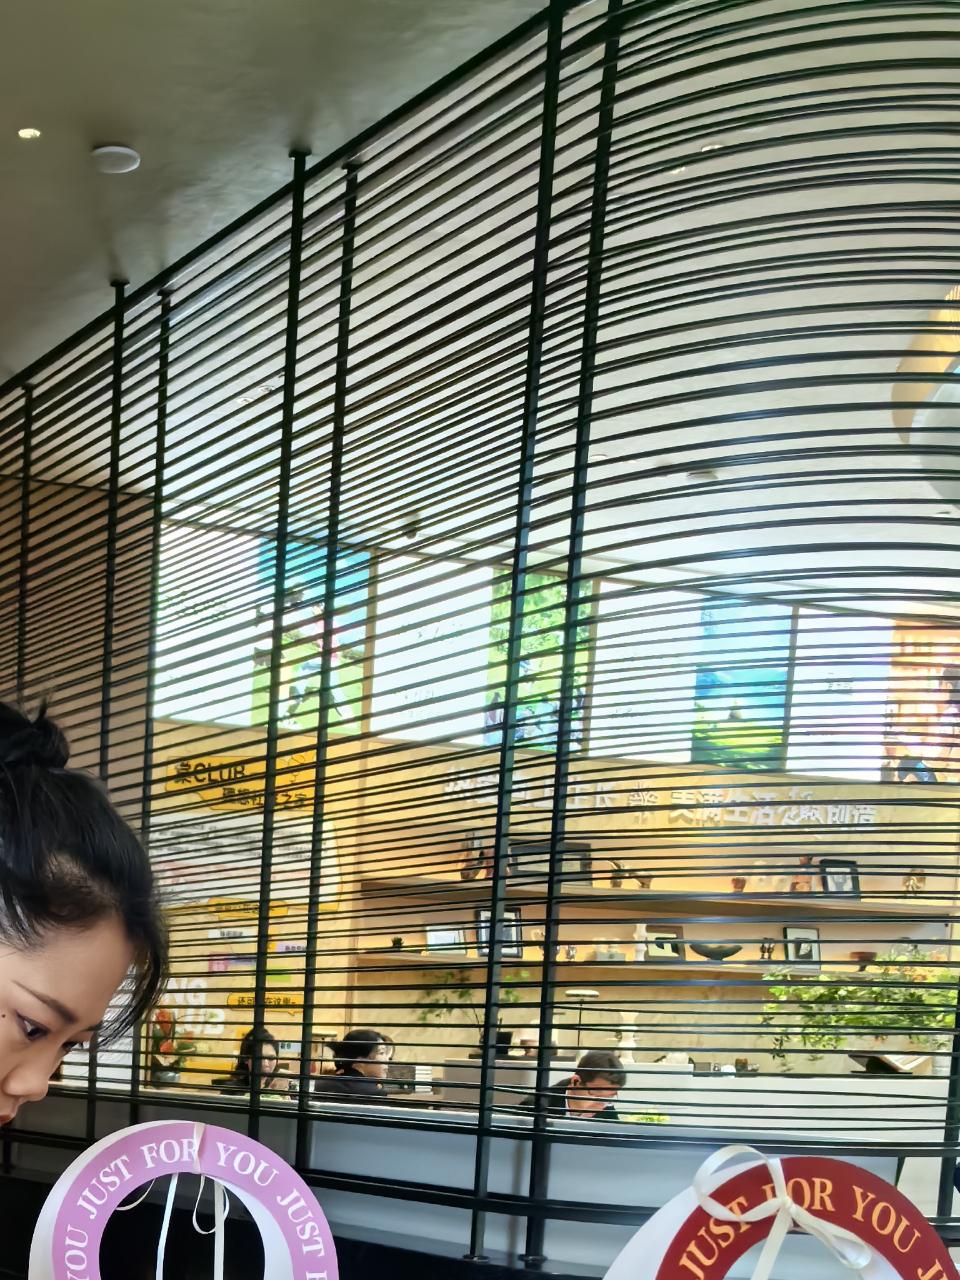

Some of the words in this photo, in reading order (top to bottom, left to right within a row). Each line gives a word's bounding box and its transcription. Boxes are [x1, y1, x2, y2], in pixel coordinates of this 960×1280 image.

[77, 1155, 134, 1219] JUST
[140, 1139, 199, 1168] FOR
[215, 1141, 279, 1187] YOU
[276, 1189, 325, 1257] JUST
[852, 1185, 921, 1254] YOU
